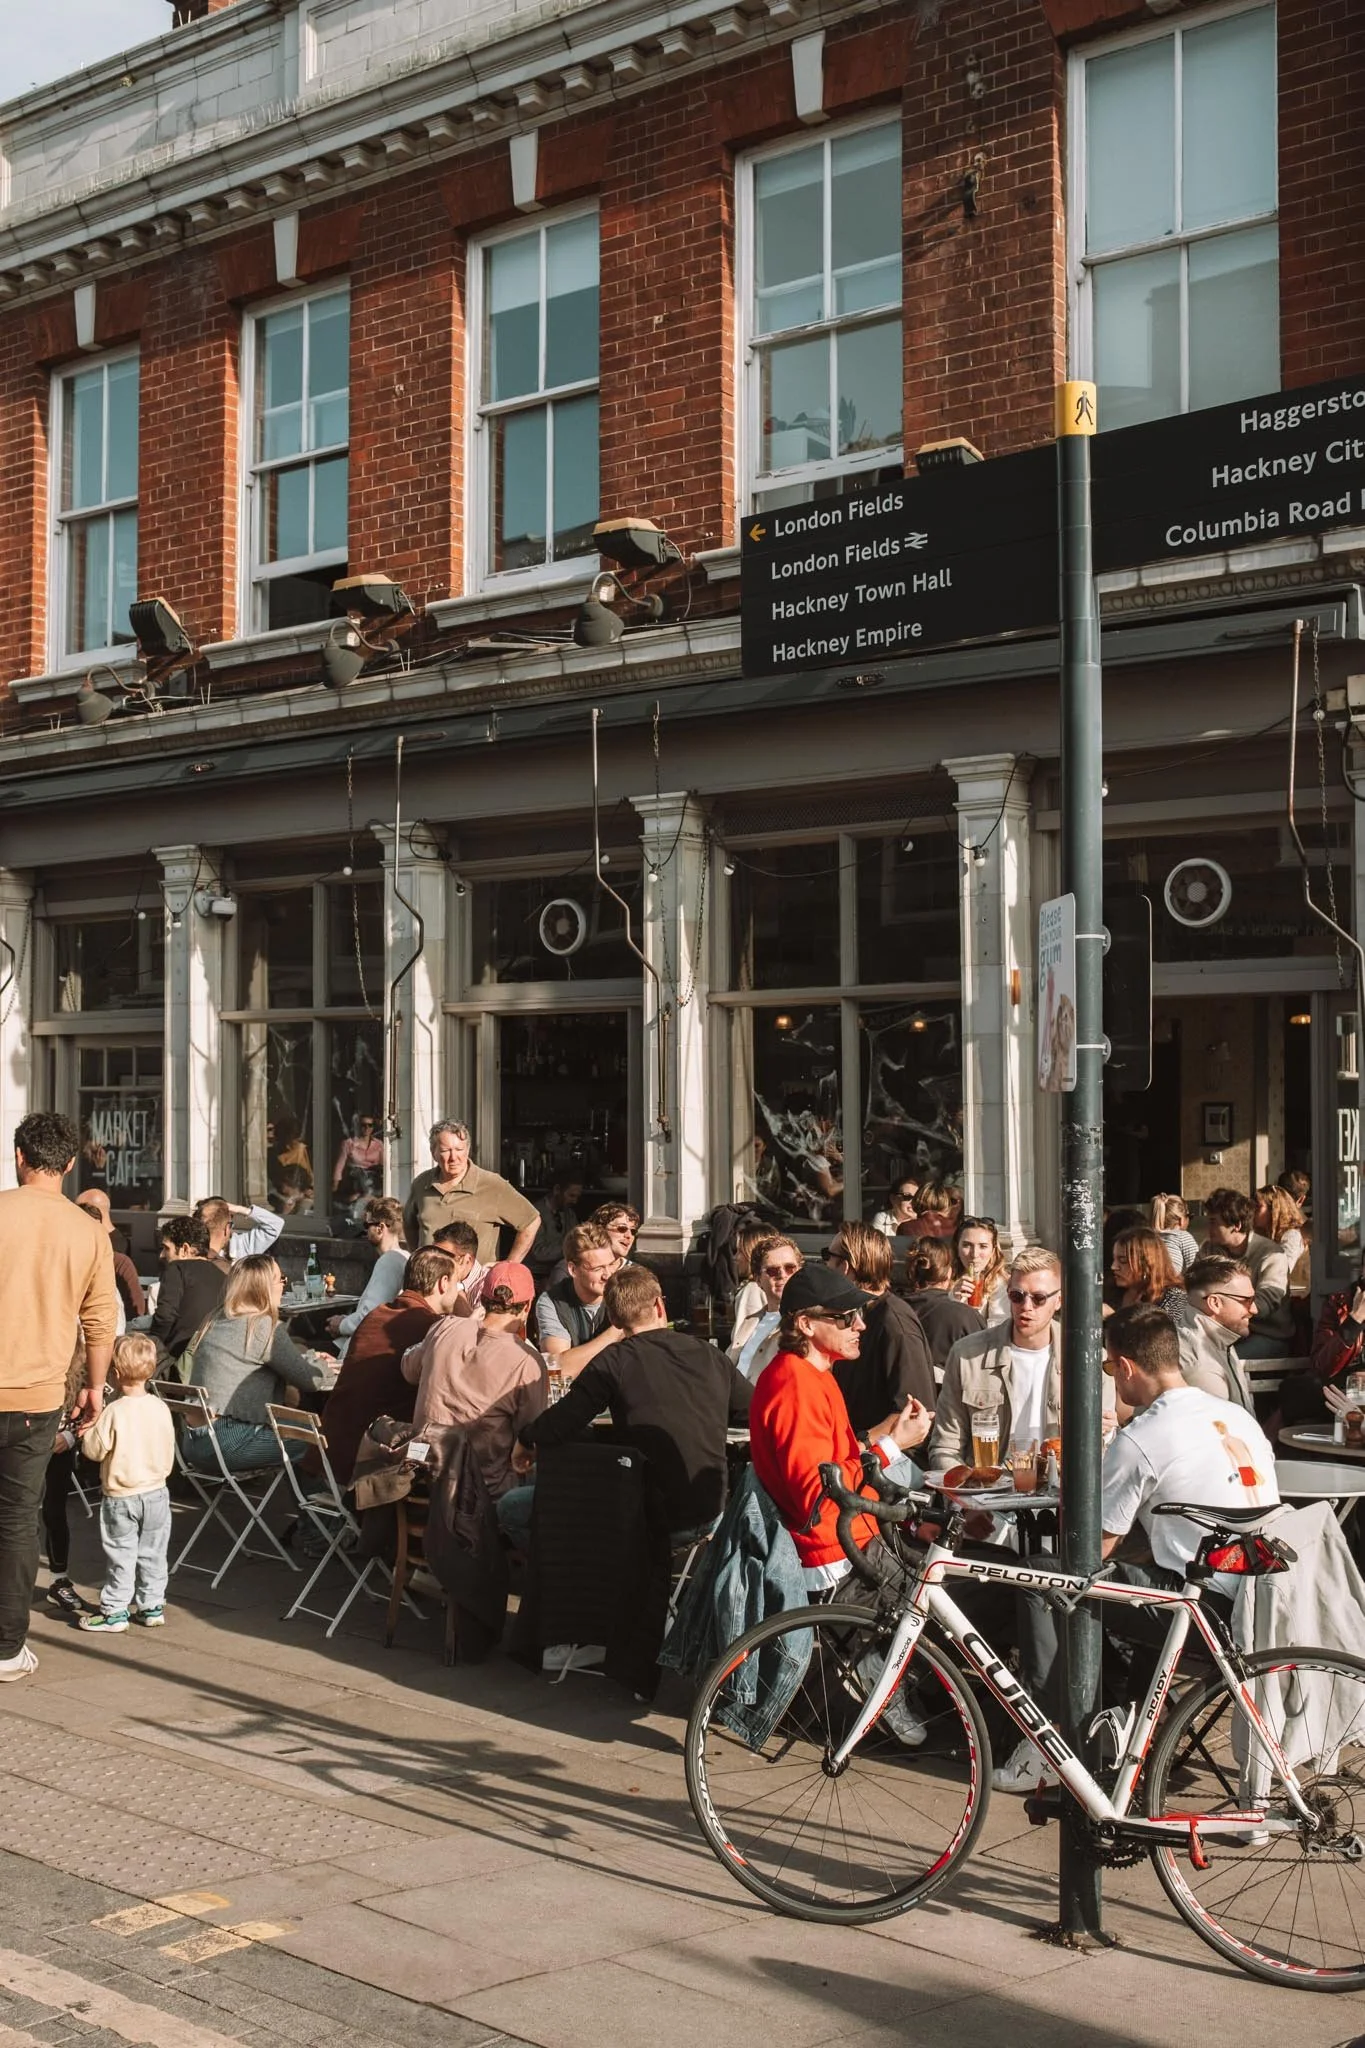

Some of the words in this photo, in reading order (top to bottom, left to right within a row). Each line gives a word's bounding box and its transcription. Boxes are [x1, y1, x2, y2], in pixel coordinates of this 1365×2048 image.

[1212, 451, 1317, 488] Hackney
[1325, 439, 1365, 464] Cit
[775, 509, 842, 537] London
[848, 493, 904, 522] Fields
[1165, 508, 1280, 547] Columbia
[1288, 491, 1351, 524] Road
[771, 552, 838, 580] London
[845, 537, 900, 565] Fields
[772, 590, 849, 620] Hackney
[855, 580, 906, 604] Town
[912, 568, 953, 594] Hall
[772, 632, 850, 663] Hackney
[856, 619, 923, 649] Empire
[1040, 906, 1062, 930] Please
[92, 1110, 149, 1148] MARKET
[105, 1150, 141, 1187] CAFE
[968, 1564, 1085, 1591] PELOTON
[963, 1632, 1075, 1766] CUBE
